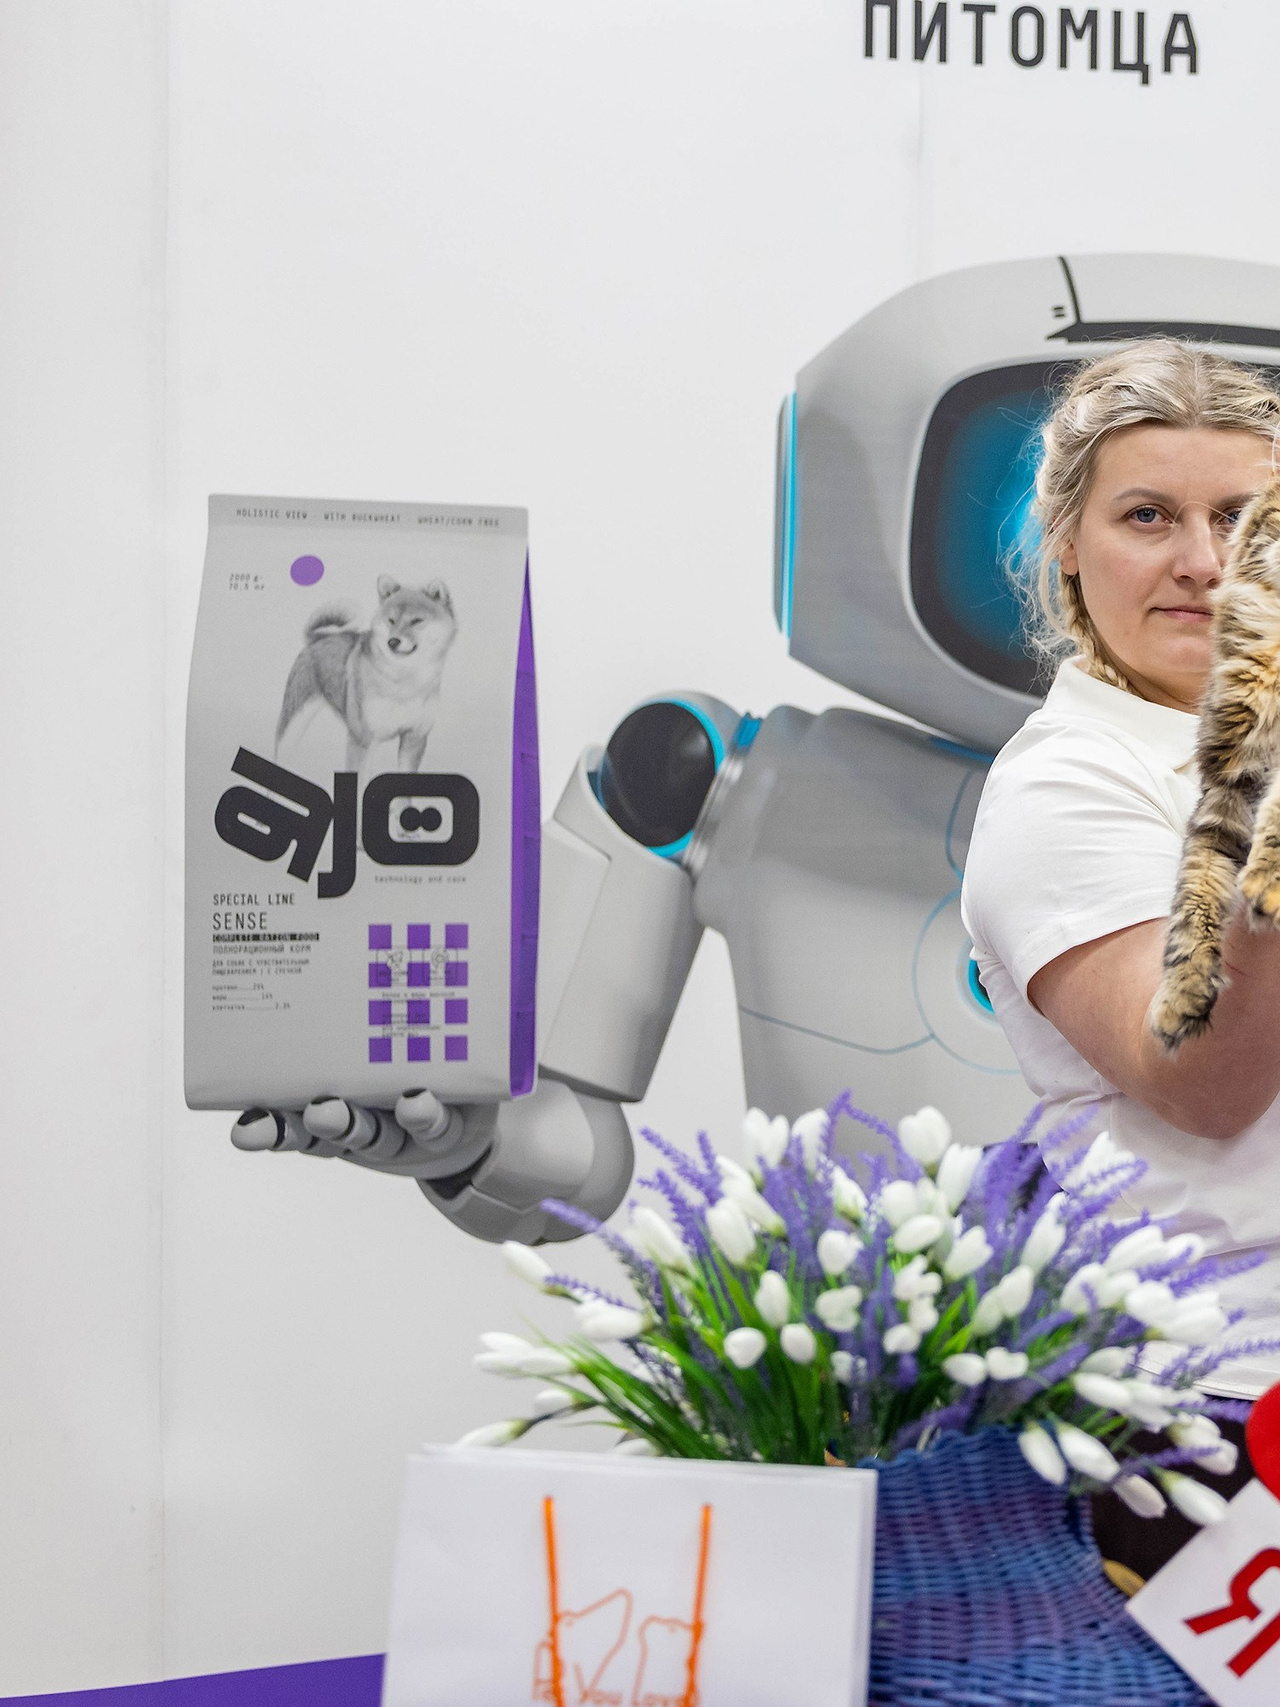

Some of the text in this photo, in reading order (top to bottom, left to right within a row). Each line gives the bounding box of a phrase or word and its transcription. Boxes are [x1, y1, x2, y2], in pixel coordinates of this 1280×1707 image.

[863, 0, 1199, 86] ПИТОМЦА
[213, 893, 294, 906] SPECIAL LINE
[212, 911, 268, 930] SENSE
